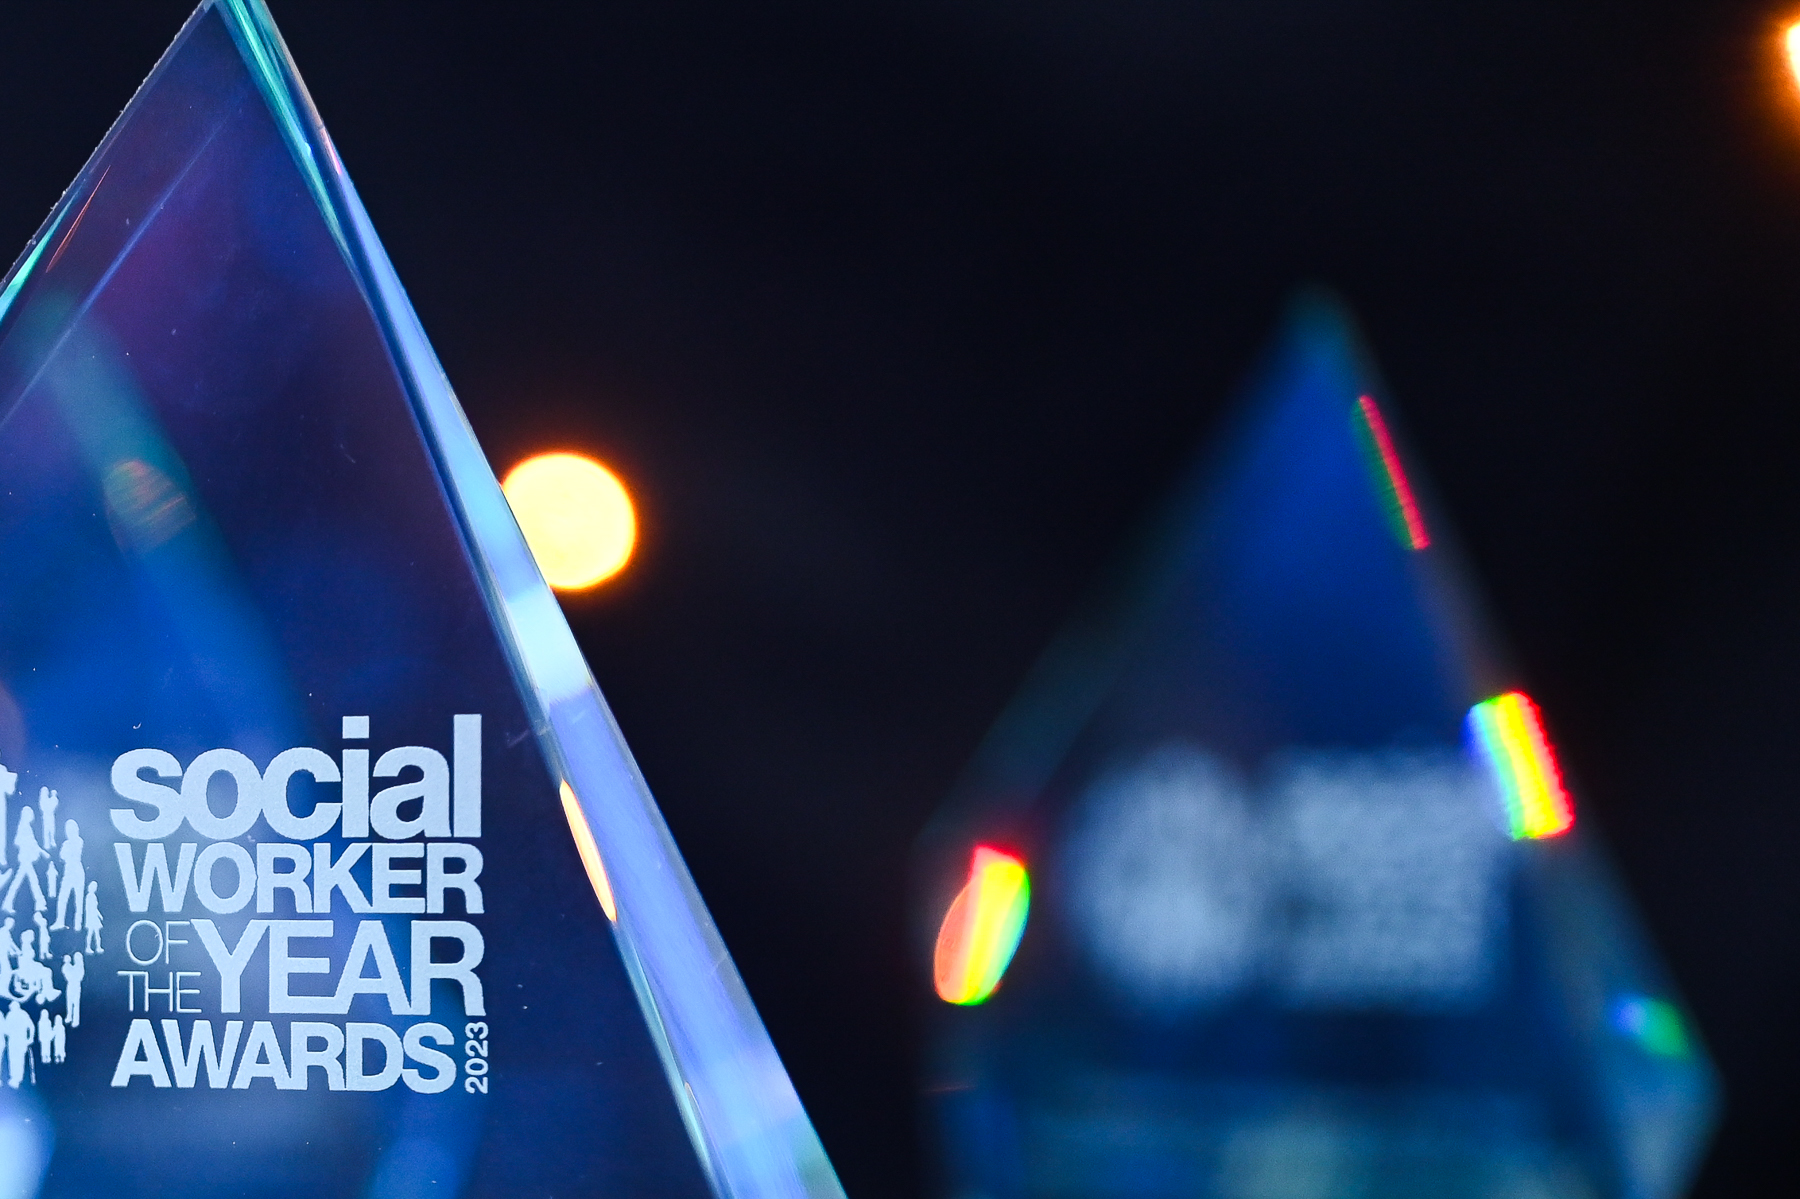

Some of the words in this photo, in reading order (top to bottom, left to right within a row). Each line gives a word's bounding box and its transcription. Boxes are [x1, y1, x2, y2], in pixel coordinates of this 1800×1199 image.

[110, 714, 482, 840] social
[114, 842, 484, 915] WORKER
[126, 920, 190, 966] OF
[191, 919, 486, 1016] YEAR
[117, 971, 201, 1013] THE
[111, 1019, 457, 1094] AWARDS
[465, 1021, 489, 1094] 2023
